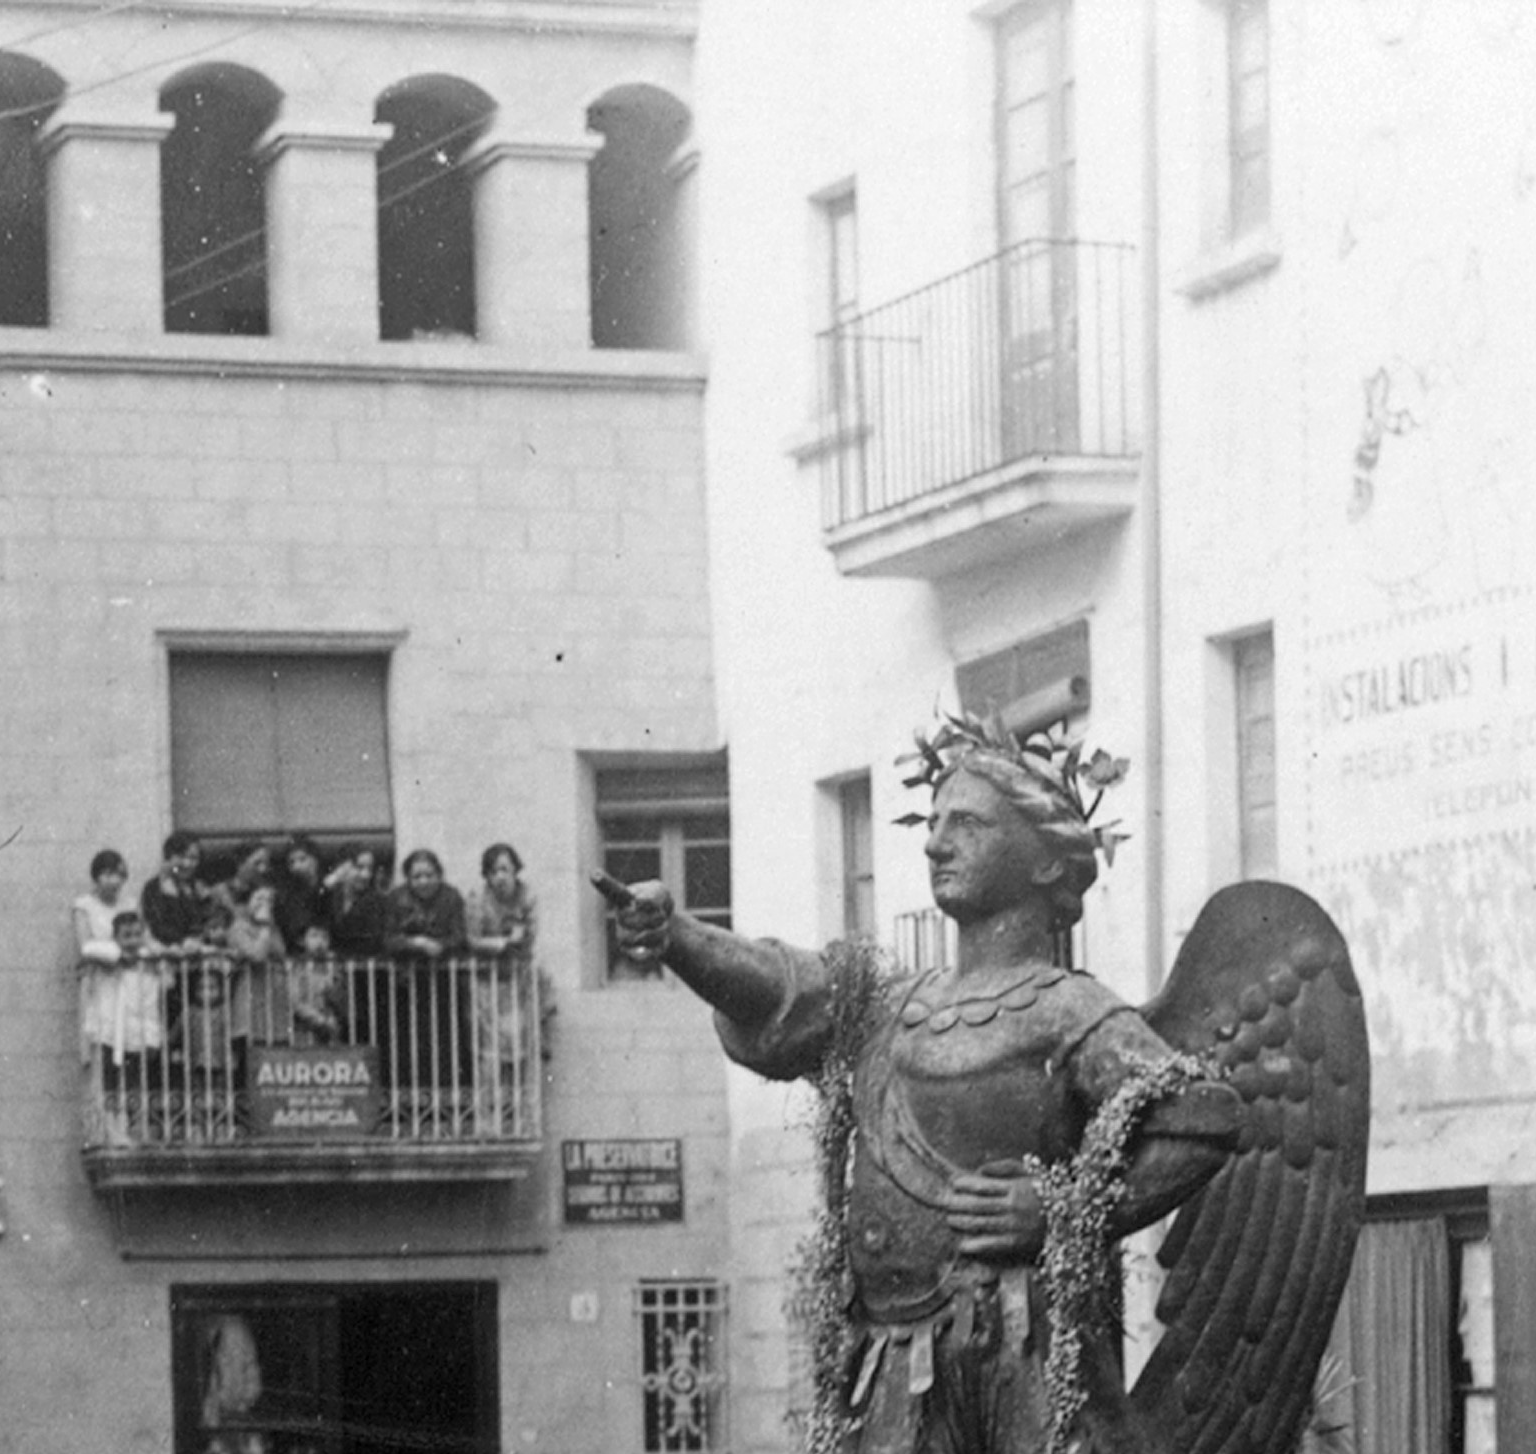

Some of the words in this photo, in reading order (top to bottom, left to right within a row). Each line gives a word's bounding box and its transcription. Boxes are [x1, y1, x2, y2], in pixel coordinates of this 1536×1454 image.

[1321, 643, 1472, 728] INSTALACIONS
[1428, 723, 1491, 770] SENS
[256, 1061, 371, 1085] AURORA
[271, 1107, 359, 1127] AGENCIA
